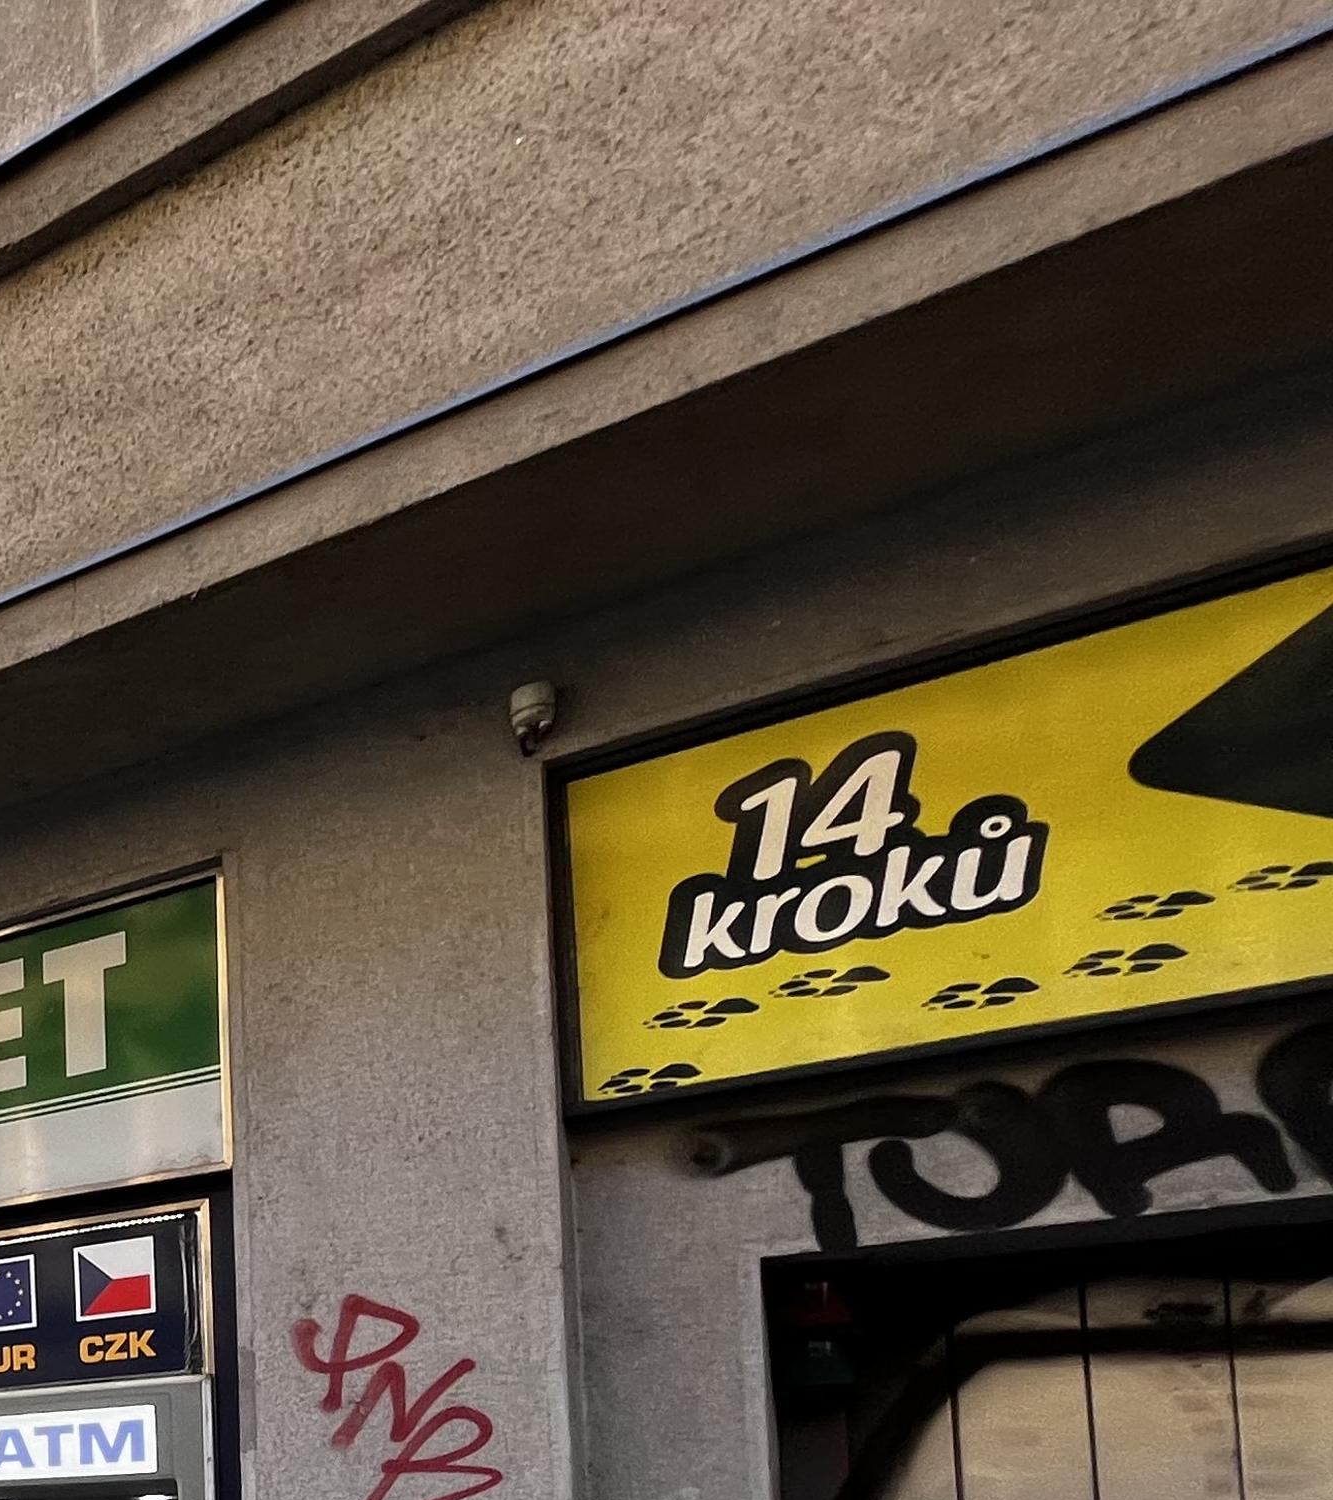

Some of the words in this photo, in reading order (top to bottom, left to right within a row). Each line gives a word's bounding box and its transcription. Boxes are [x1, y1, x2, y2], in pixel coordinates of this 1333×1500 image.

[740, 750, 905, 880] 14
[683, 814, 1034, 969] kroků
[79, 1329, 156, 1364] CZK
